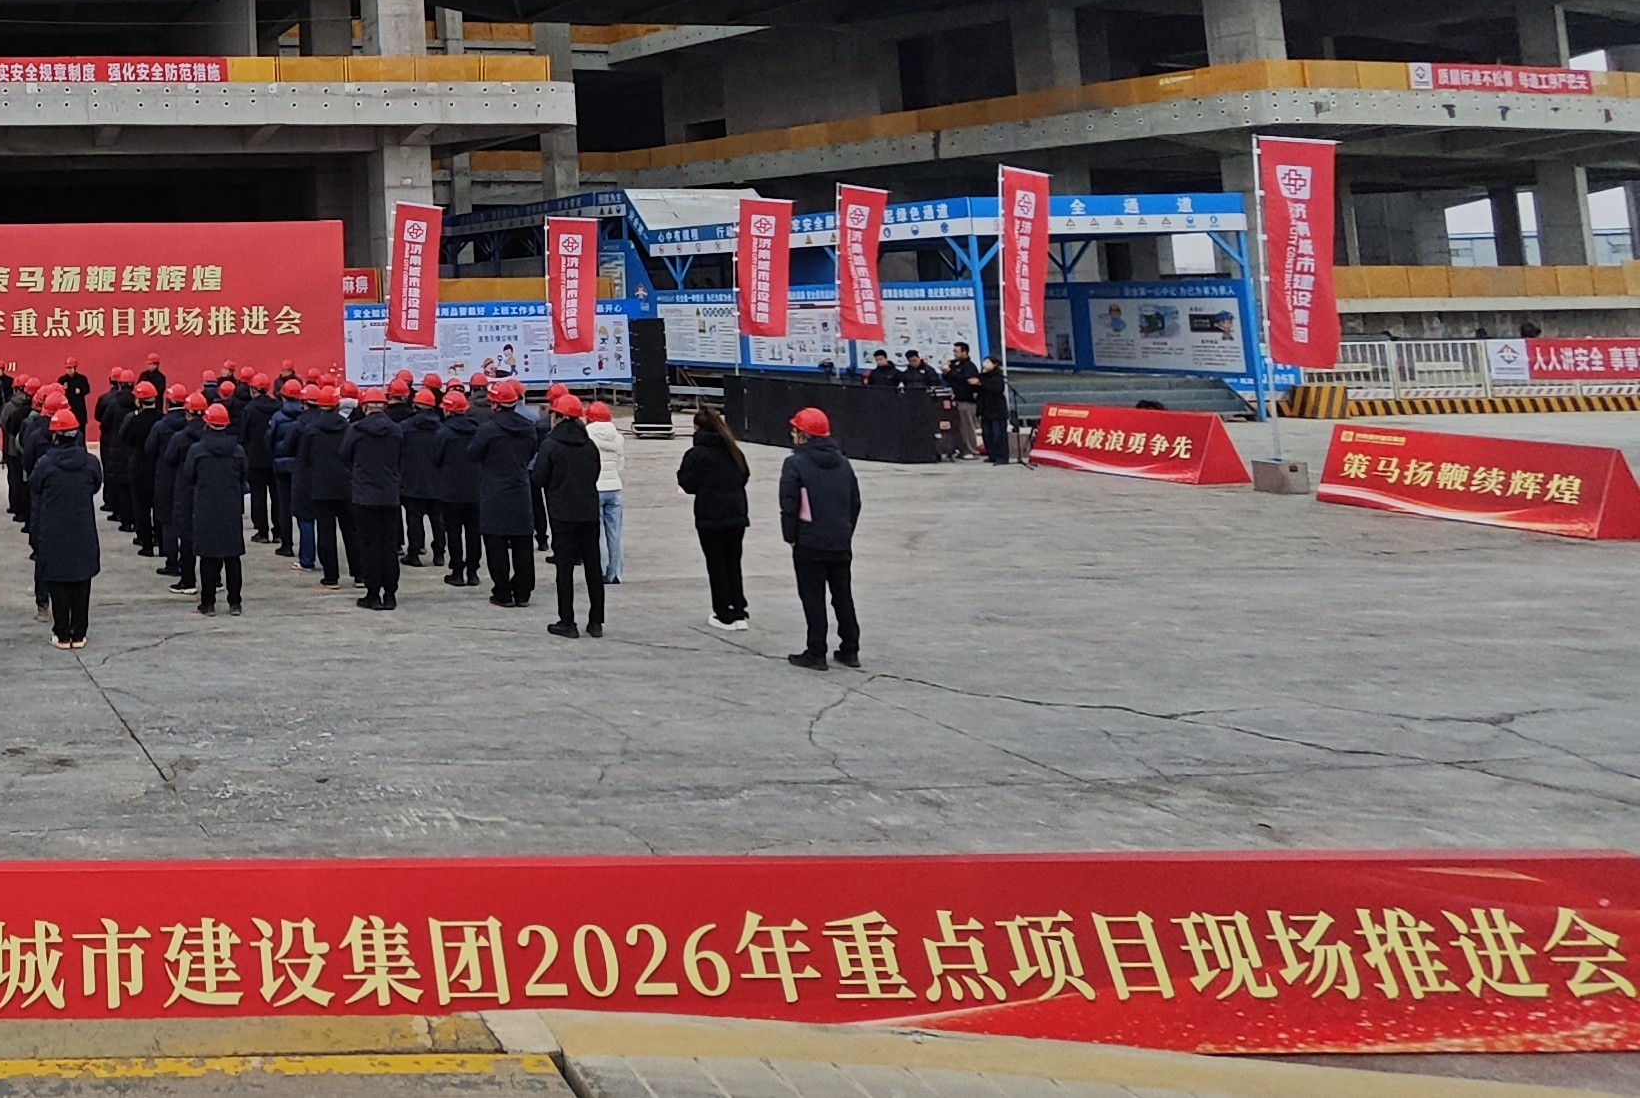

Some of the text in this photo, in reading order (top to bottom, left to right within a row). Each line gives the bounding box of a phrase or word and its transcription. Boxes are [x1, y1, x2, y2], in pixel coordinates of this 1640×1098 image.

[107, 62, 221, 81] 强化安全防范措施
[1533, 347, 1640, 371] 人人讲安全 事事
[1045, 424, 1193, 459] 乘风破浪勇争先
[1339, 452, 1582, 505] 策马扬鞭续辉煌
